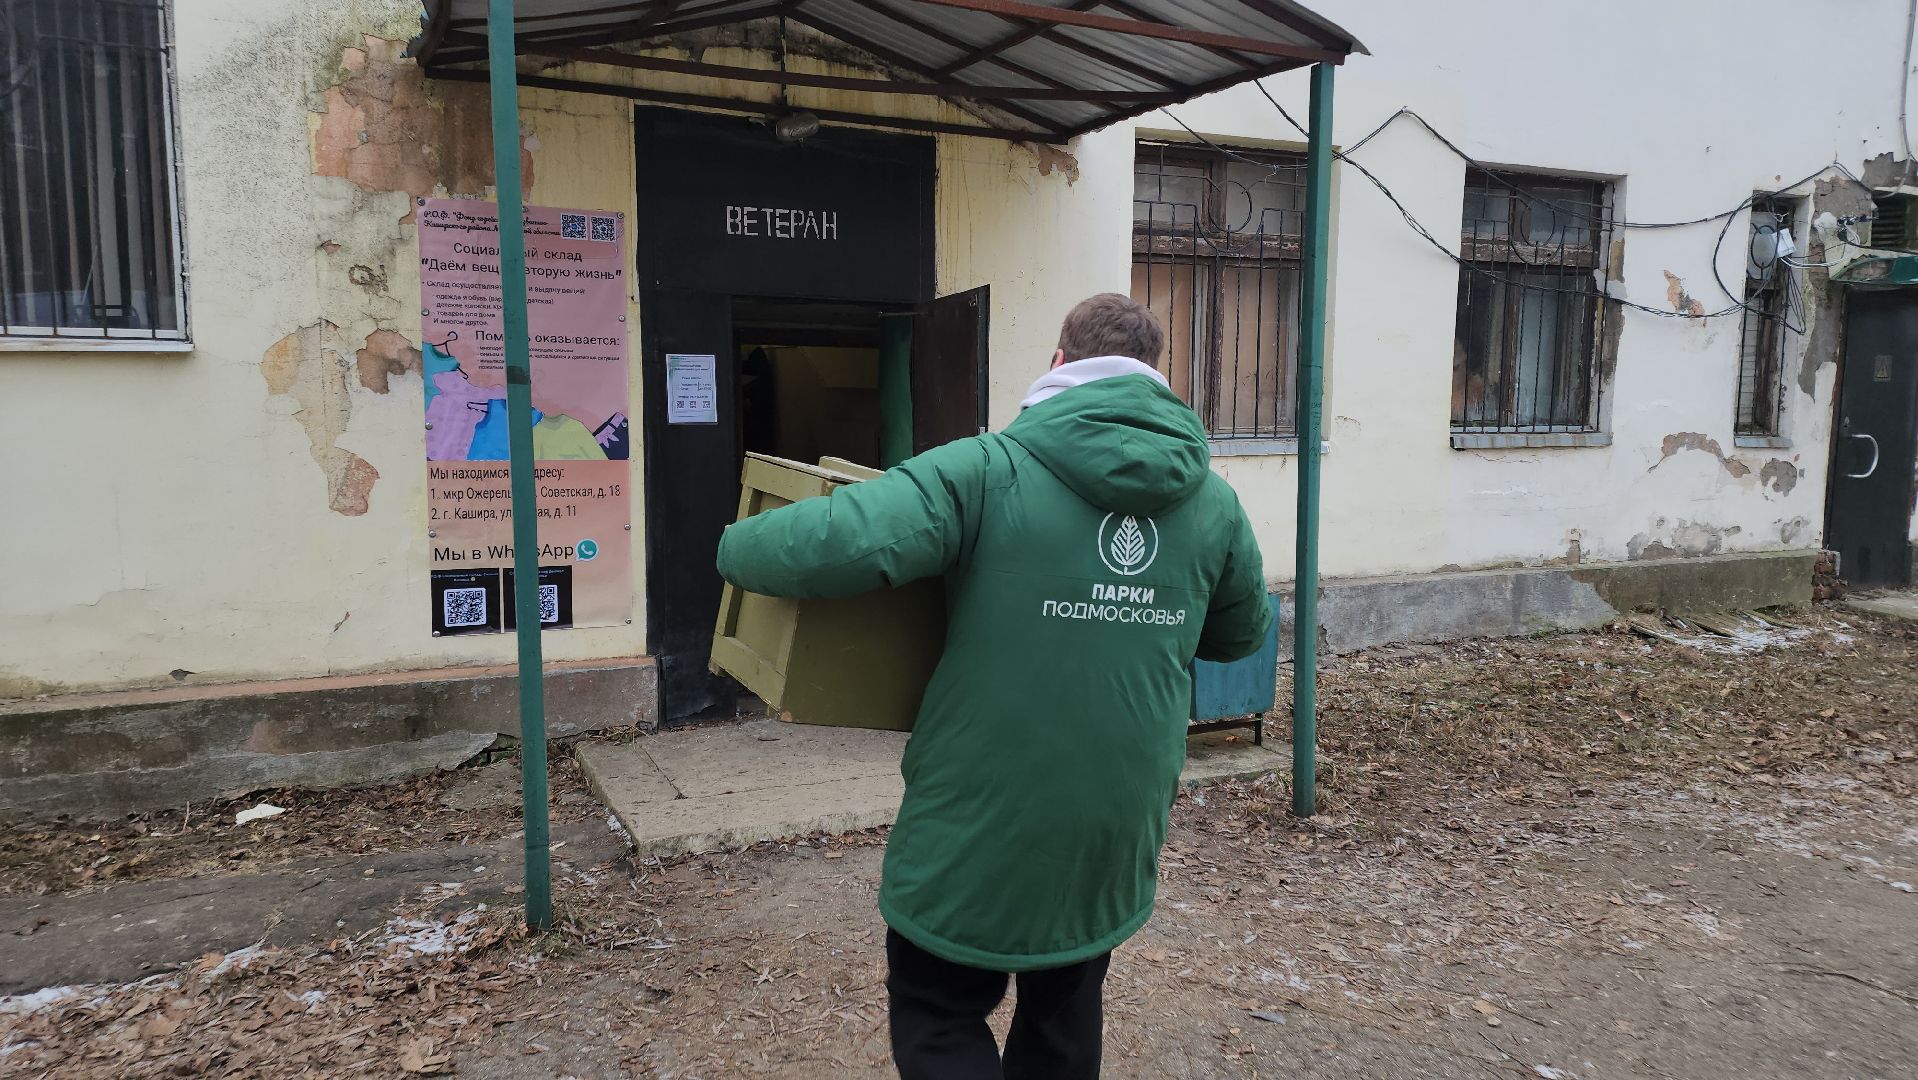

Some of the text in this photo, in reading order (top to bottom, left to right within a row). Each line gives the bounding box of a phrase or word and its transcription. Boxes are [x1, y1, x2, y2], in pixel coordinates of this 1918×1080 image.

[726, 205, 837, 240] ВЕТЕРАН
[453, 242, 582, 263] Социаый склад
[421, 258, 622, 280] "Даём вещ вторую жизнь"
[452, 282, 502, 291] осуществляе
[535, 334, 620, 346] оказывается:
[430, 468, 565, 481] Мы находимся дресу:
[431, 488, 441, 500] 1.
[443, 490, 464, 502] мкр
[540, 485, 596, 499] Советская,
[597, 487, 607, 498] д.
[609, 485, 621, 497] 18
[431, 507, 441, 520] 2.
[443, 510, 451, 520] г.
[454, 507, 498, 521] Кашира,
[554, 507, 563, 519] д.
[566, 505, 576, 517] 11
[434, 543, 574, 561] Мы в WhsApp
[1091, 583, 1156, 605] ПАРКИ
[1042, 600, 1187, 626] ПОДМОСКОВЬЯ
